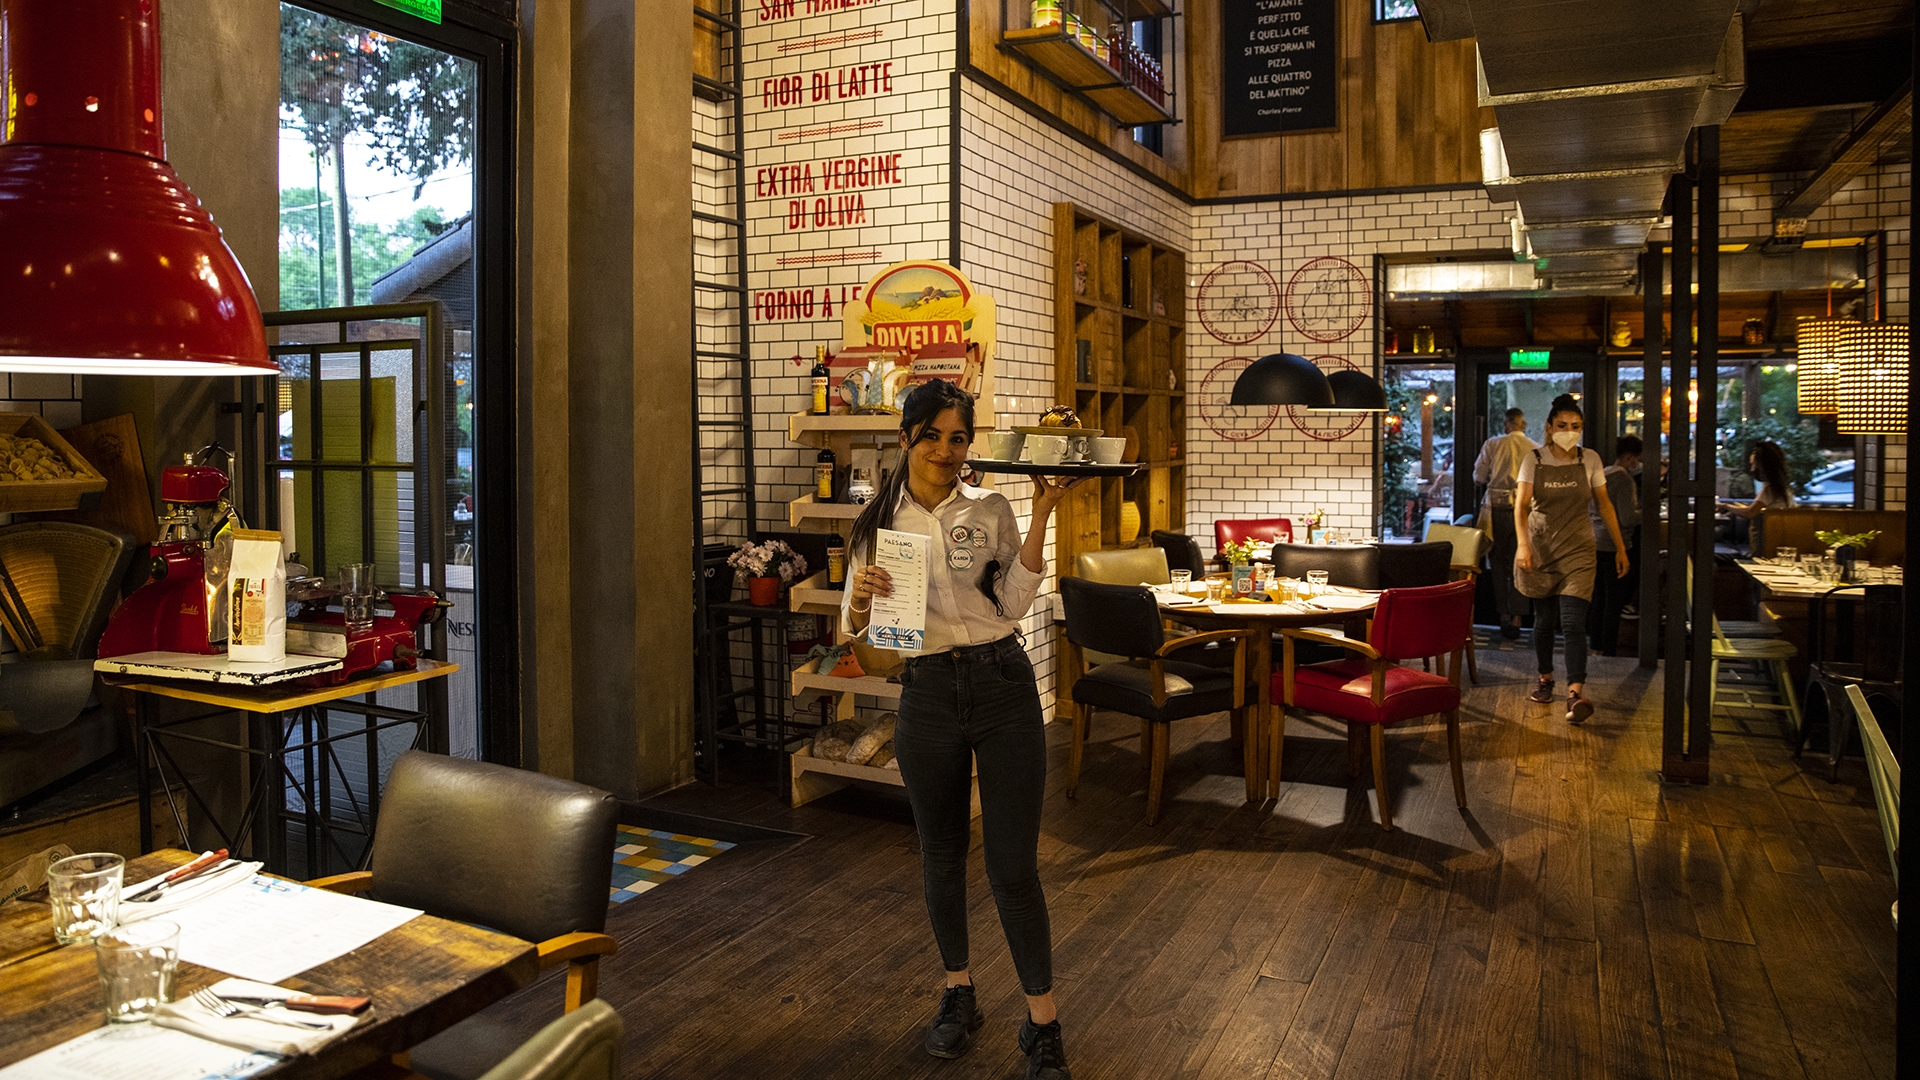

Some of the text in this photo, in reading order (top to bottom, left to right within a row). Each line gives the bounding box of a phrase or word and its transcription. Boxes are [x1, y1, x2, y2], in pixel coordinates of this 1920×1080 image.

[396, 0, 440, 16] ERGENCIA
[1258, 12, 1302, 25] PERFETTO
[1257, 28, 1291, 41] QUELLA
[1292, 25, 1310, 36] CHE
[1244, 40, 1316, 56] SI TRASFORMA IN
[1267, 58, 1292, 68] PIZZA
[763, 62, 893, 108] FIOR DI LATTE
[1248, 70, 1312, 85] ALLE QUATTRO
[1249, 90, 1266, 100] DEL
[1257, 106, 1302, 116] Charles Pierce
[757, 153, 902, 198] EXTRA VERGINE
[789, 194, 866, 230] DI OLIVA
[755, 289, 814, 321] FORNO
[822, 288, 833, 317] A
[876, 324, 958, 350] DIVELLA
[1307, 329, 1348, 339] POMODORO
[1543, 481, 1578, 489] PAESANO
[884, 537, 913, 548] PAESANO
[446, 618, 476, 638] NES
